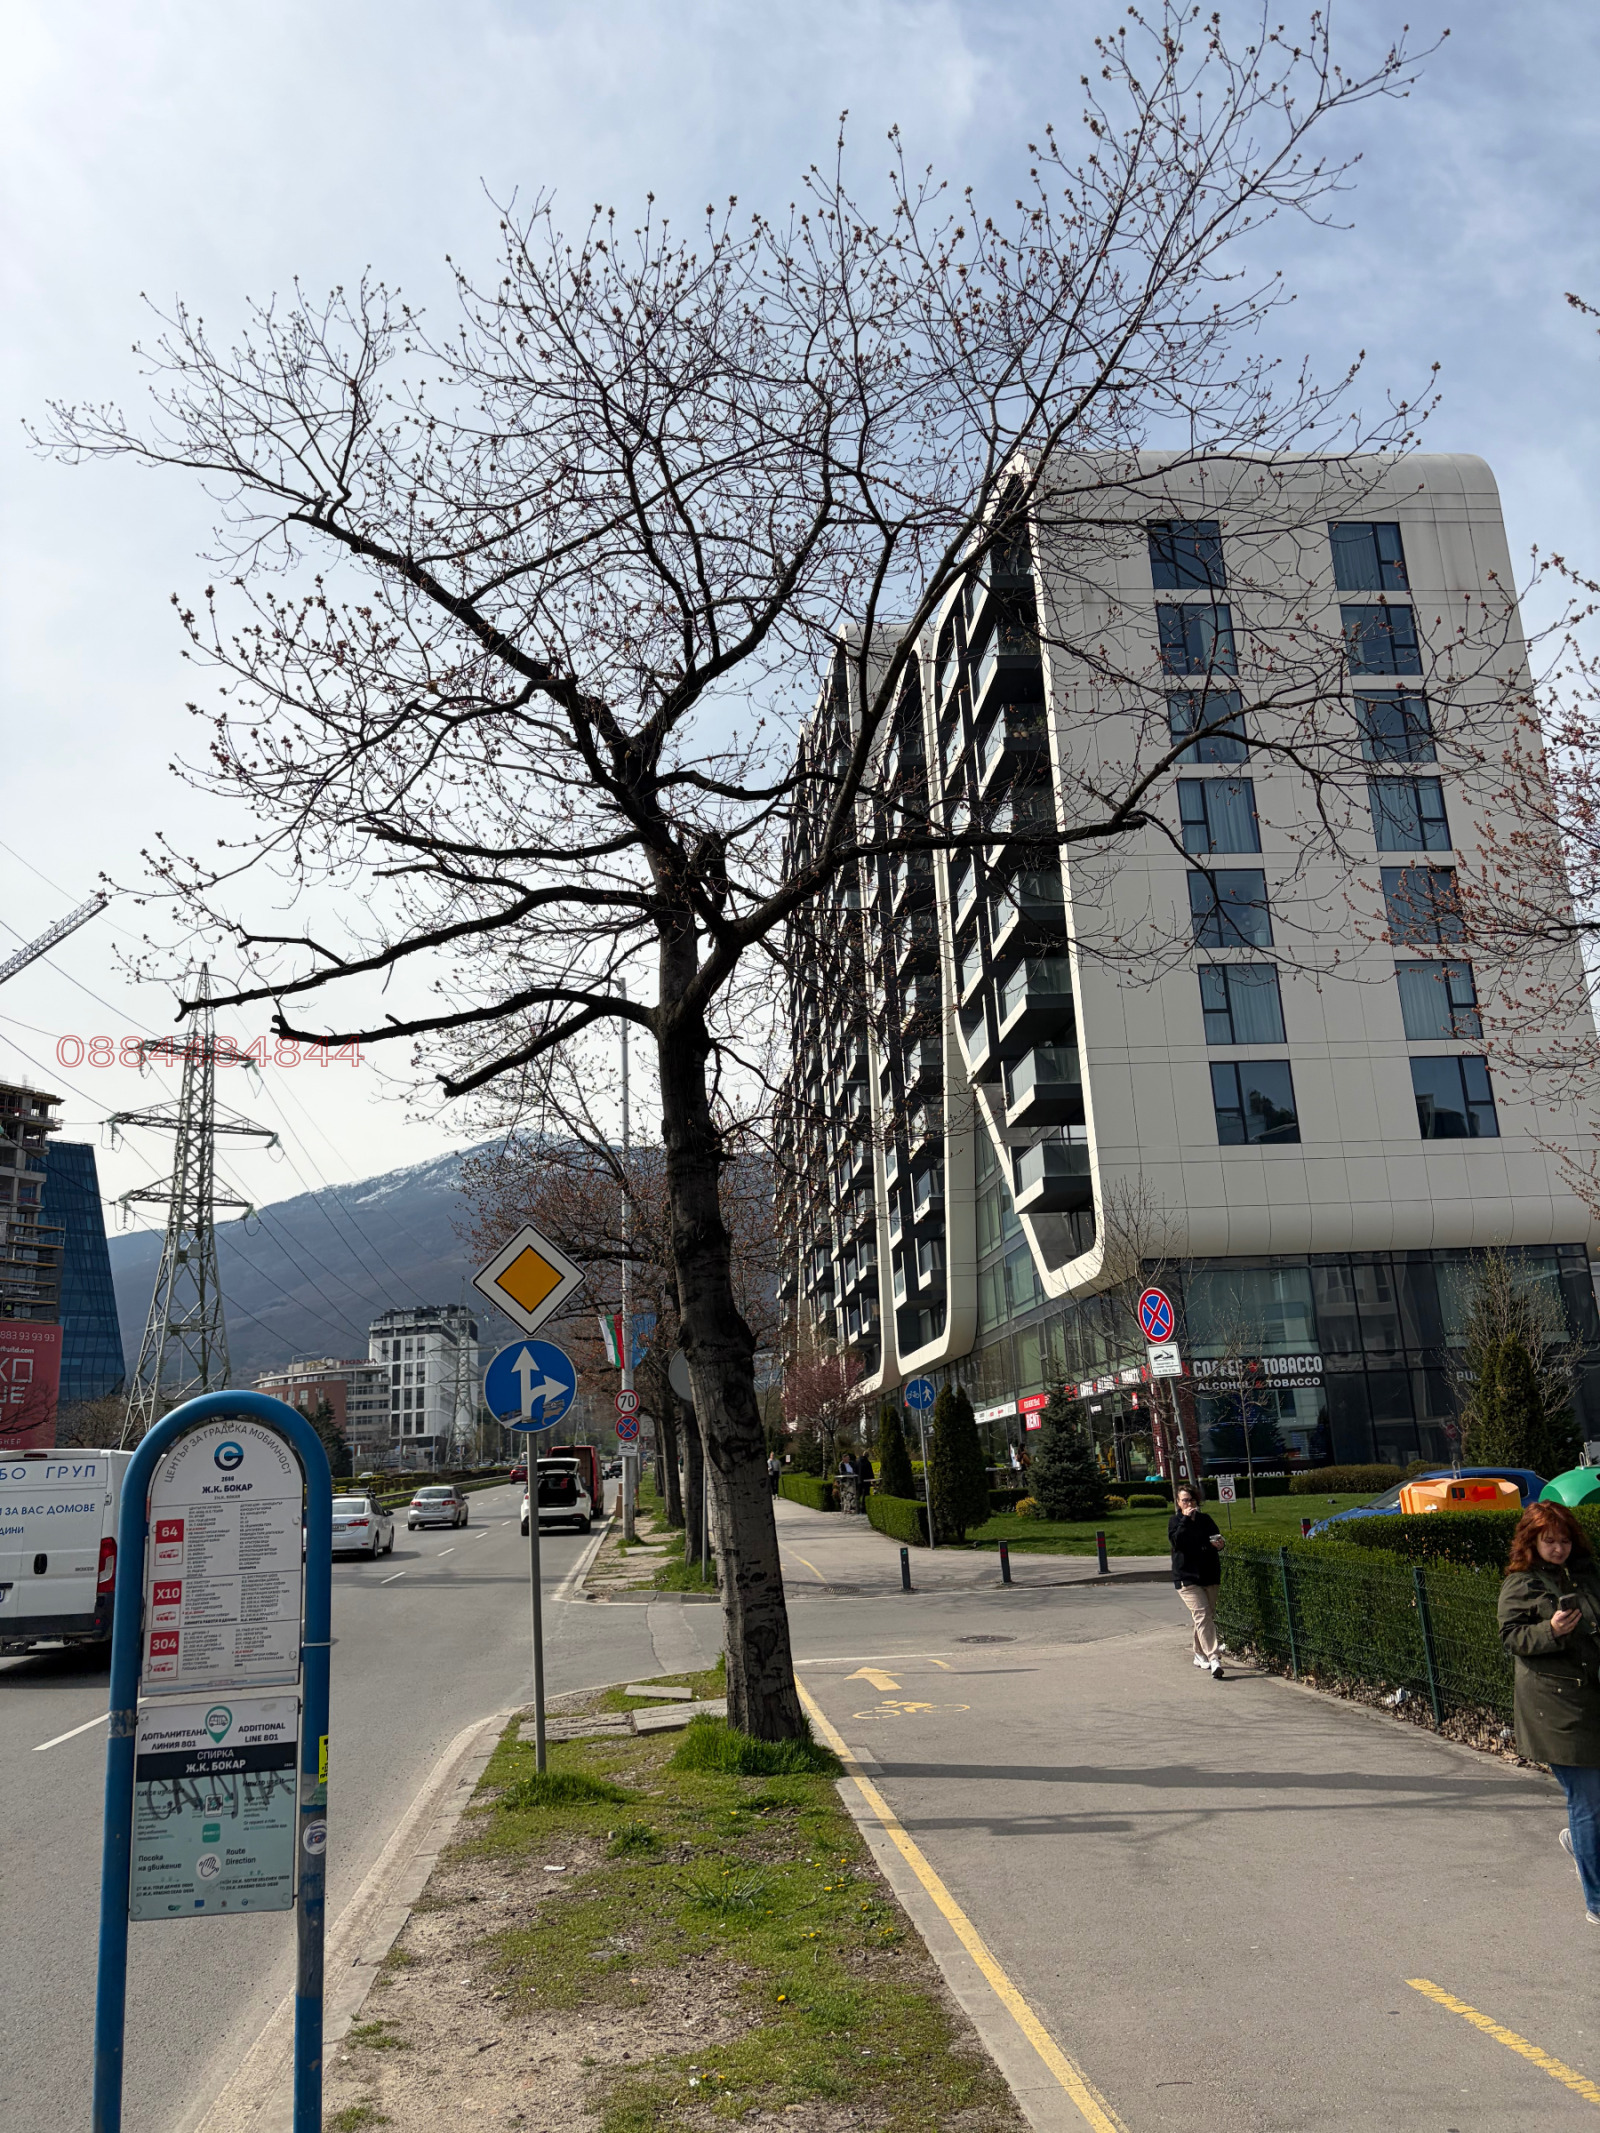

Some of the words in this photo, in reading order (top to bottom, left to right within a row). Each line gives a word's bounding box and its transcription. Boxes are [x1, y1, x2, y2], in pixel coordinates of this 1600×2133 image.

[44, 1333, 55, 1342] 93
[341, 1358, 377, 1366] HONDA
[1261, 1356, 1323, 1374] TOBACCO
[1267, 1377, 1321, 1388] TOBACCO
[620, 1395, 635, 1408] 70
[164, 1445, 189, 1483] ЦЕНТЪР
[190, 1437, 204, 1447] ЗА
[204, 1423, 247, 1438] ГРАДСКА
[250, 1429, 292, 1475] МОБИЛНОСТ
[46, 1465, 96, 1479] ГРУП
[202, 1486, 222, 1494] Ж.К.
[224, 1484, 253, 1492] БОКАР
[5, 1507, 18, 1516] ЗА
[21, 1505, 44, 1515] ВАС
[47, 1503, 96, 1515] ДОМОВЕ
[162, 1527, 178, 1537] 64
[156, 1588, 180, 1600] X10
[152, 1638, 177, 1650] 304
[238, 1723, 286, 1733] ADDITIONAL
[141, 1728, 208, 1741] ДОПЪЛНИТЕЛНА
[245, 1735, 263, 1743] LINE
[264, 1734, 279, 1742] 801
[152, 1742, 180, 1751] ЛИНИЯ
[181, 1740, 197, 1748] 801
[197, 1749, 234, 1760] СПИРКА
[185, 1763, 210, 1773] Ж.К.
[211, 1760, 246, 1771] БОКАР
[225, 1857, 256, 1865] Direction
